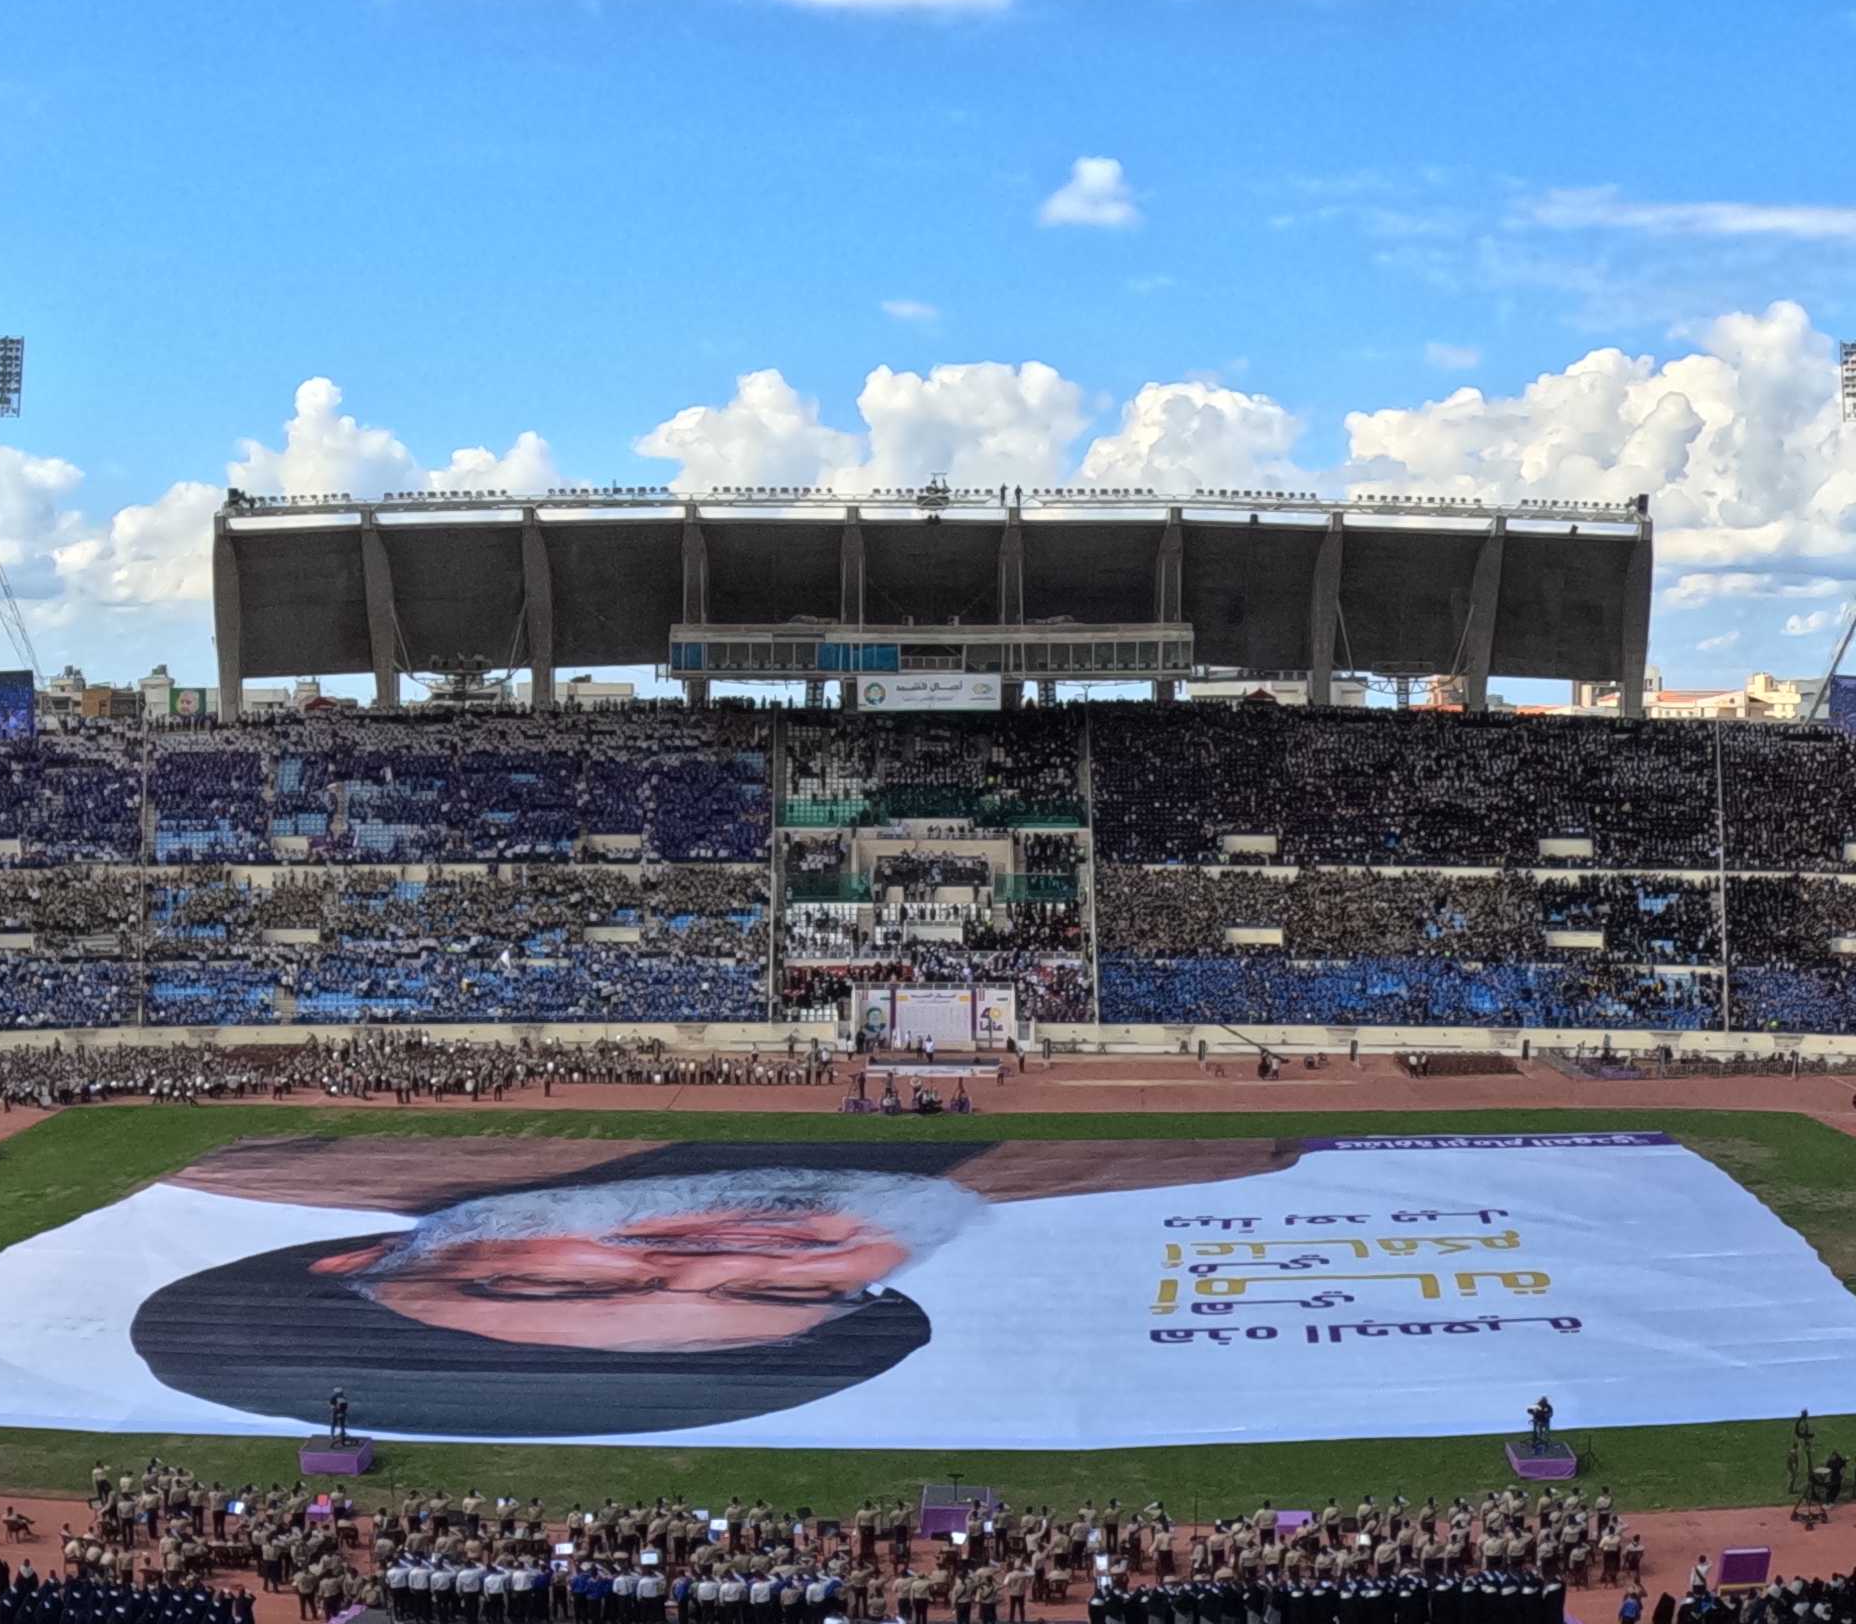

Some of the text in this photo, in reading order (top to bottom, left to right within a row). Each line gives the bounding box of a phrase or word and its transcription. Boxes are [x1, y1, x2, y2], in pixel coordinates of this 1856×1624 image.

[1284, 1213, 1372, 1227] بعد
[1390, 1208, 1510, 1226] جيل
[1162, 1229, 1522, 1269] أعناقكم
[1187, 1253, 1330, 1278] في
[1148, 1271, 1552, 1316] أمانة
[1190, 1290, 1356, 1316] هي
[1148, 1315, 1584, 1346] هذه الجمعية
